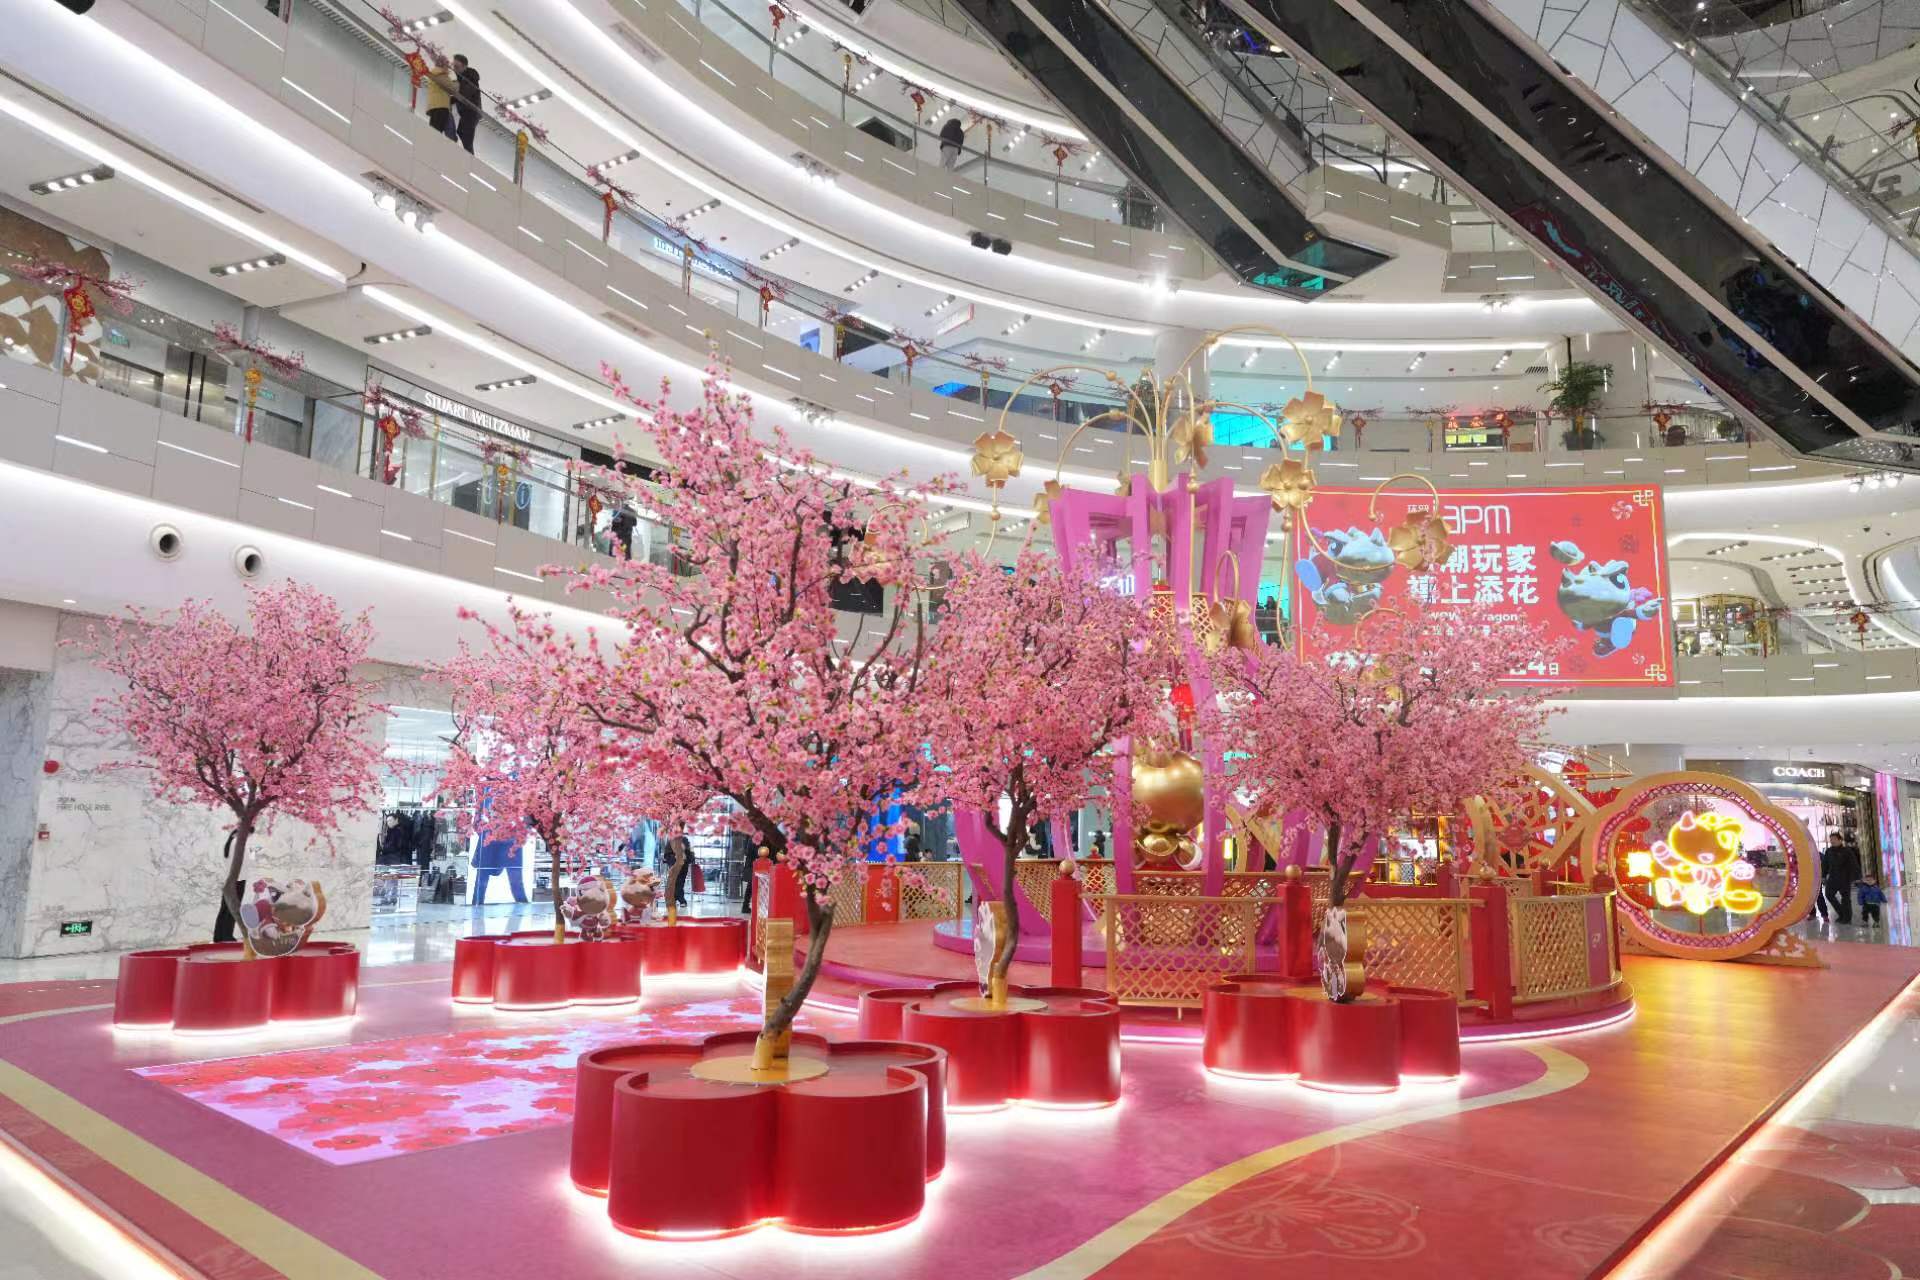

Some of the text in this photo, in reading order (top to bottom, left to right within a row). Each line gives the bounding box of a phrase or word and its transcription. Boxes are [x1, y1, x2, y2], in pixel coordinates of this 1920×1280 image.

[424, 392, 531, 442] STUART WEITZMAN
[1481, 612, 1518, 624] ragon
[1772, 766, 1825, 779] COACH
